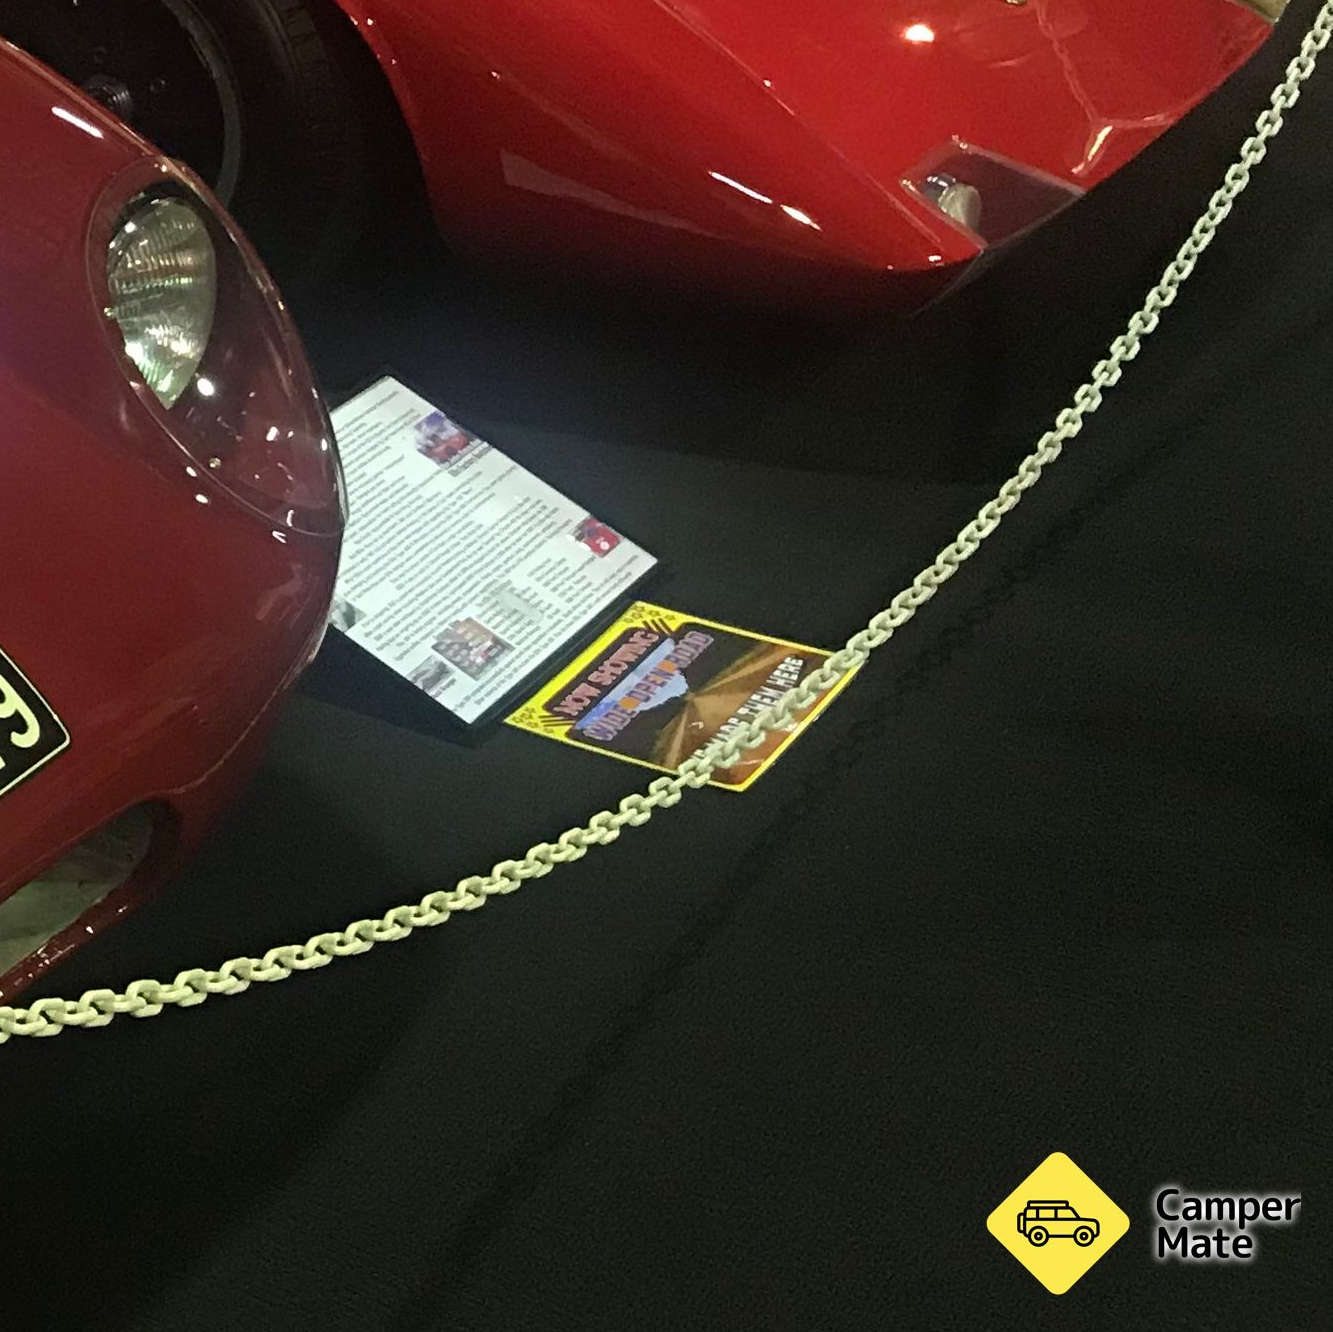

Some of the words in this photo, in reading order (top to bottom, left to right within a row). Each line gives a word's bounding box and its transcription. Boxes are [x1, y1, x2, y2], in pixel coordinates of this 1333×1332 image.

[551, 682, 603, 717] NOW
[587, 629, 661, 686] SHOWING
[581, 702, 639, 742] WIDE
[624, 666, 676, 703] OPEN
[665, 629, 716, 667] ROAD
[765, 656, 804, 689] HERE
